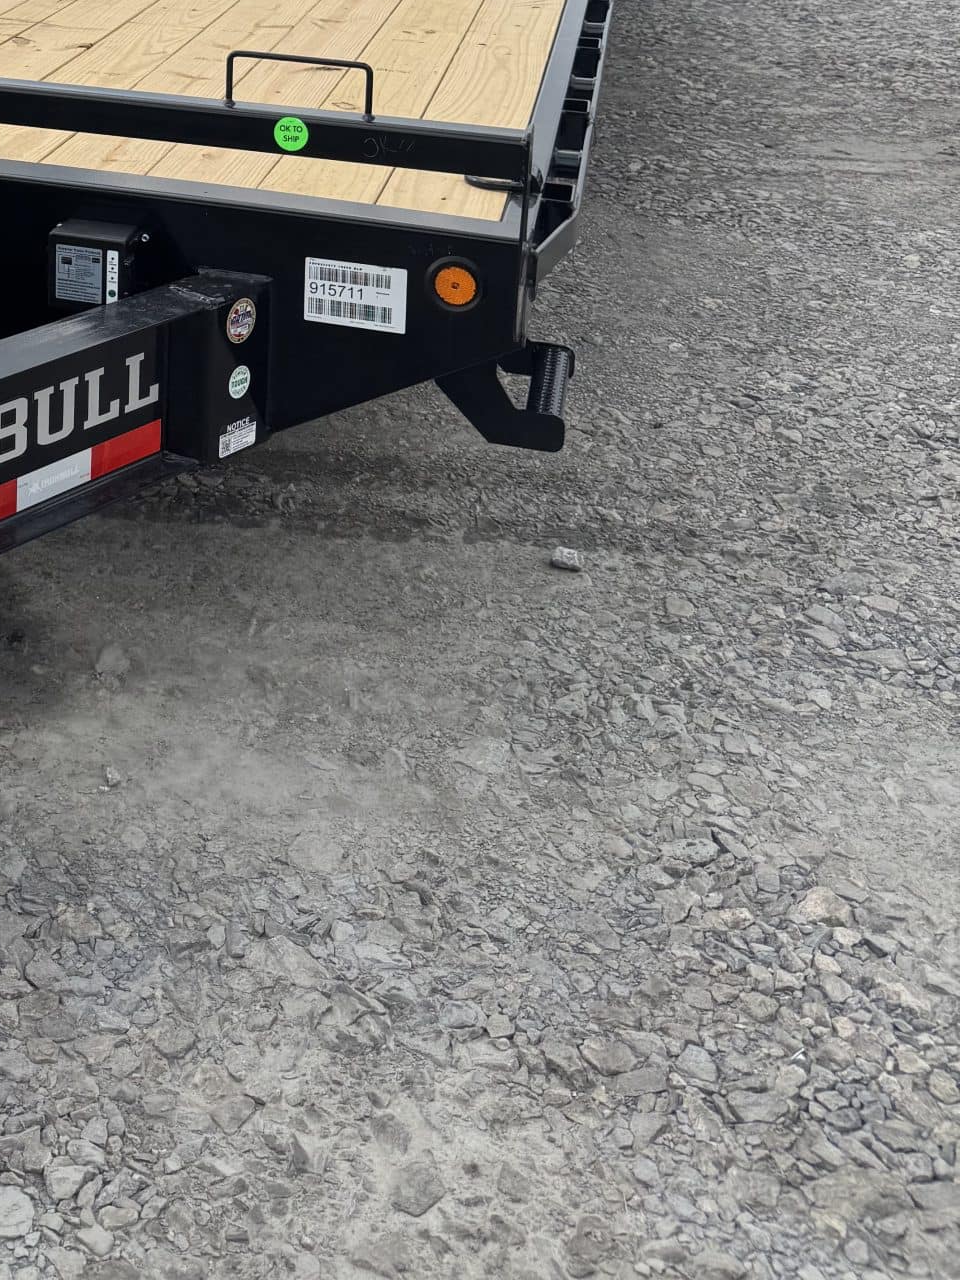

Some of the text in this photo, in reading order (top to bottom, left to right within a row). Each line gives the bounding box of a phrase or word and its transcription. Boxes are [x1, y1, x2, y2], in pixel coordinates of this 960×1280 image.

[279, 124, 303, 133] OK TO
[283, 134, 300, 143] SHIP
[309, 281, 363, 301] 915711
[227, 416, 250, 433] NOTICE
